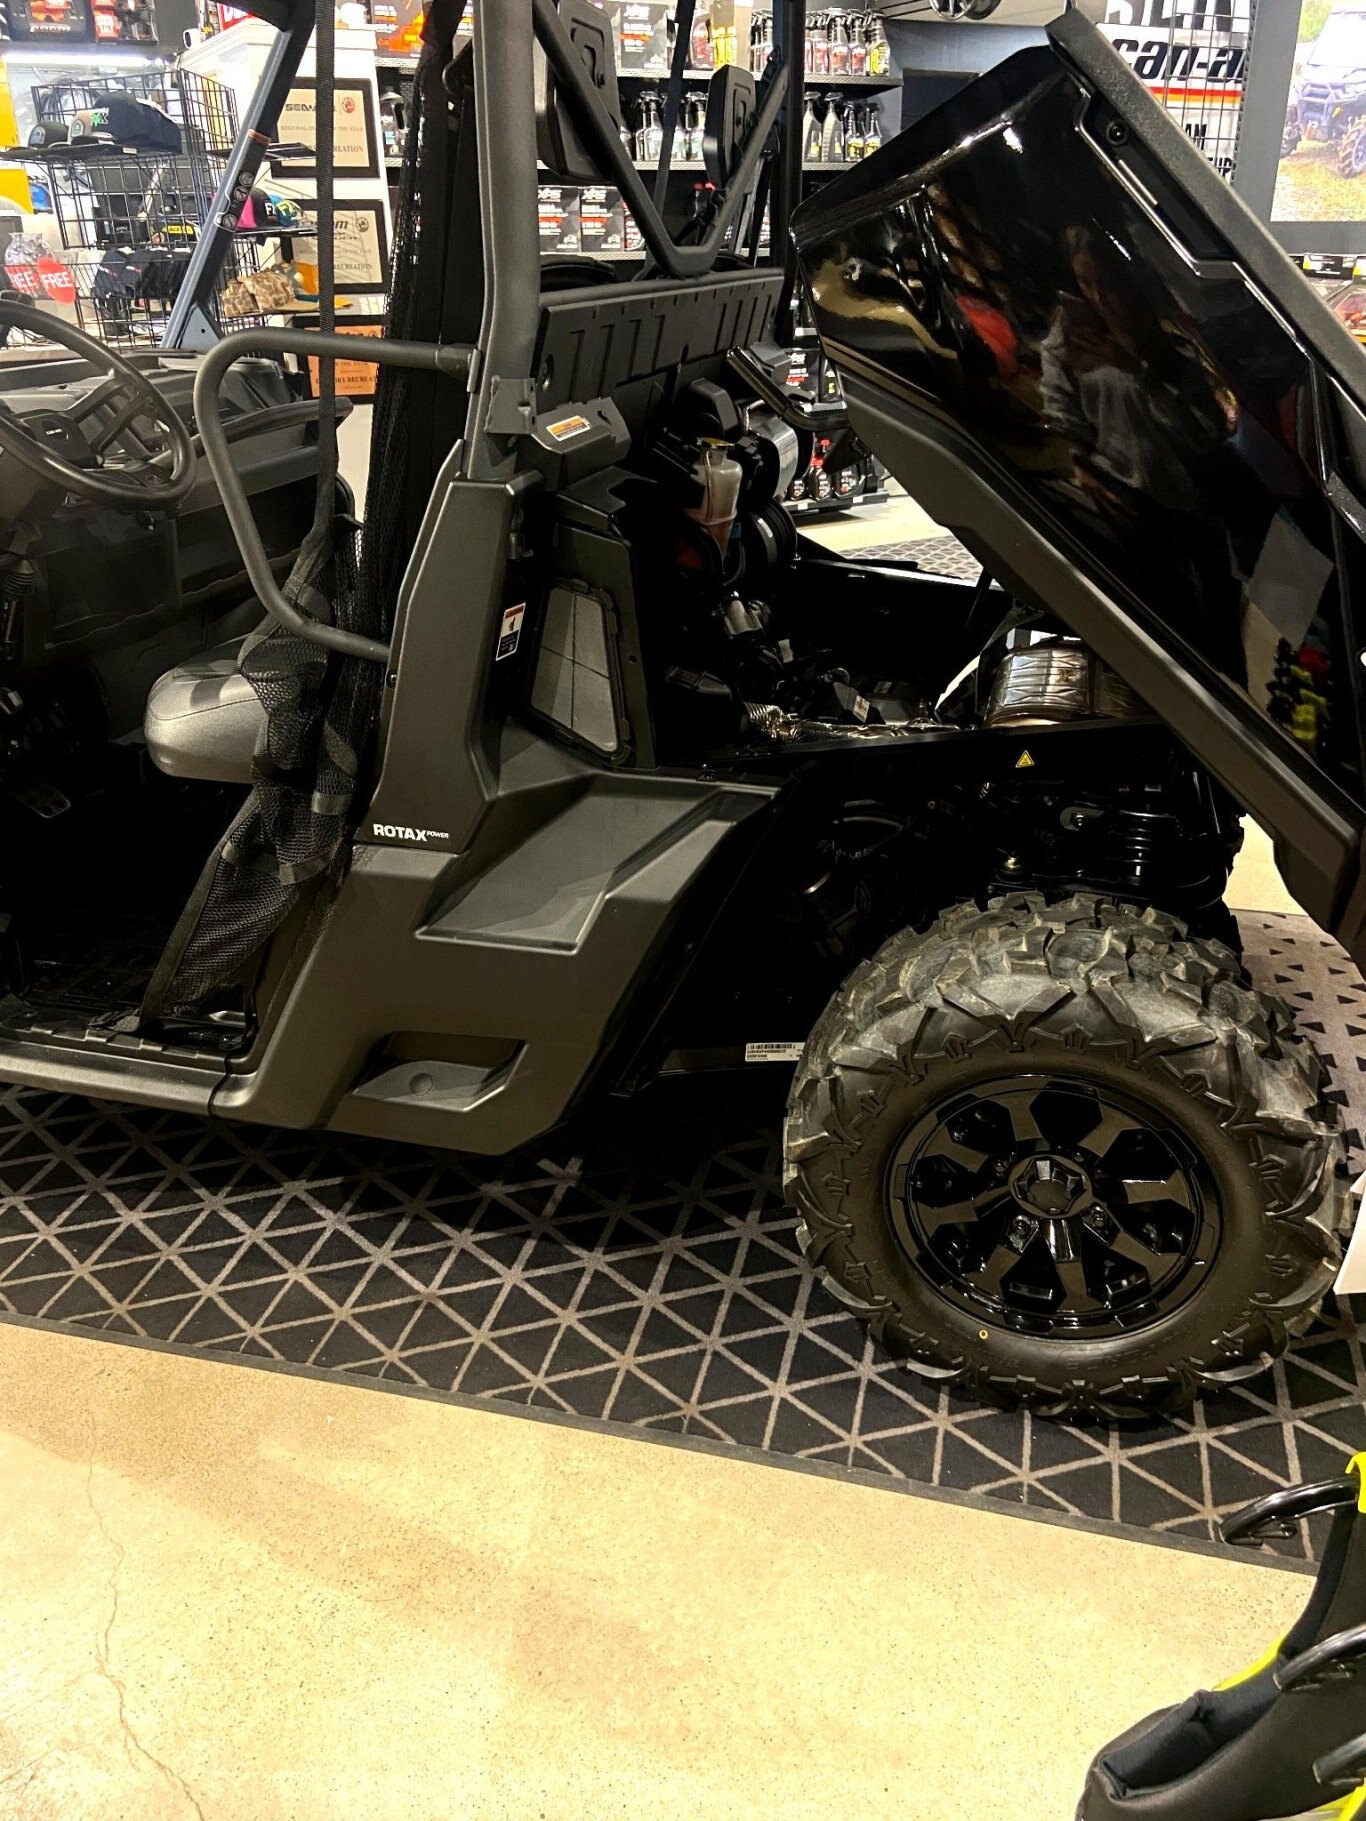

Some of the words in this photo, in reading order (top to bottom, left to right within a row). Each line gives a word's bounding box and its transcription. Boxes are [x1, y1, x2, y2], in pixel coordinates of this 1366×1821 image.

[40, 272, 74, 289] FREE
[373, 823, 427, 841] ROTAX
[426, 830, 449, 838] POWER
